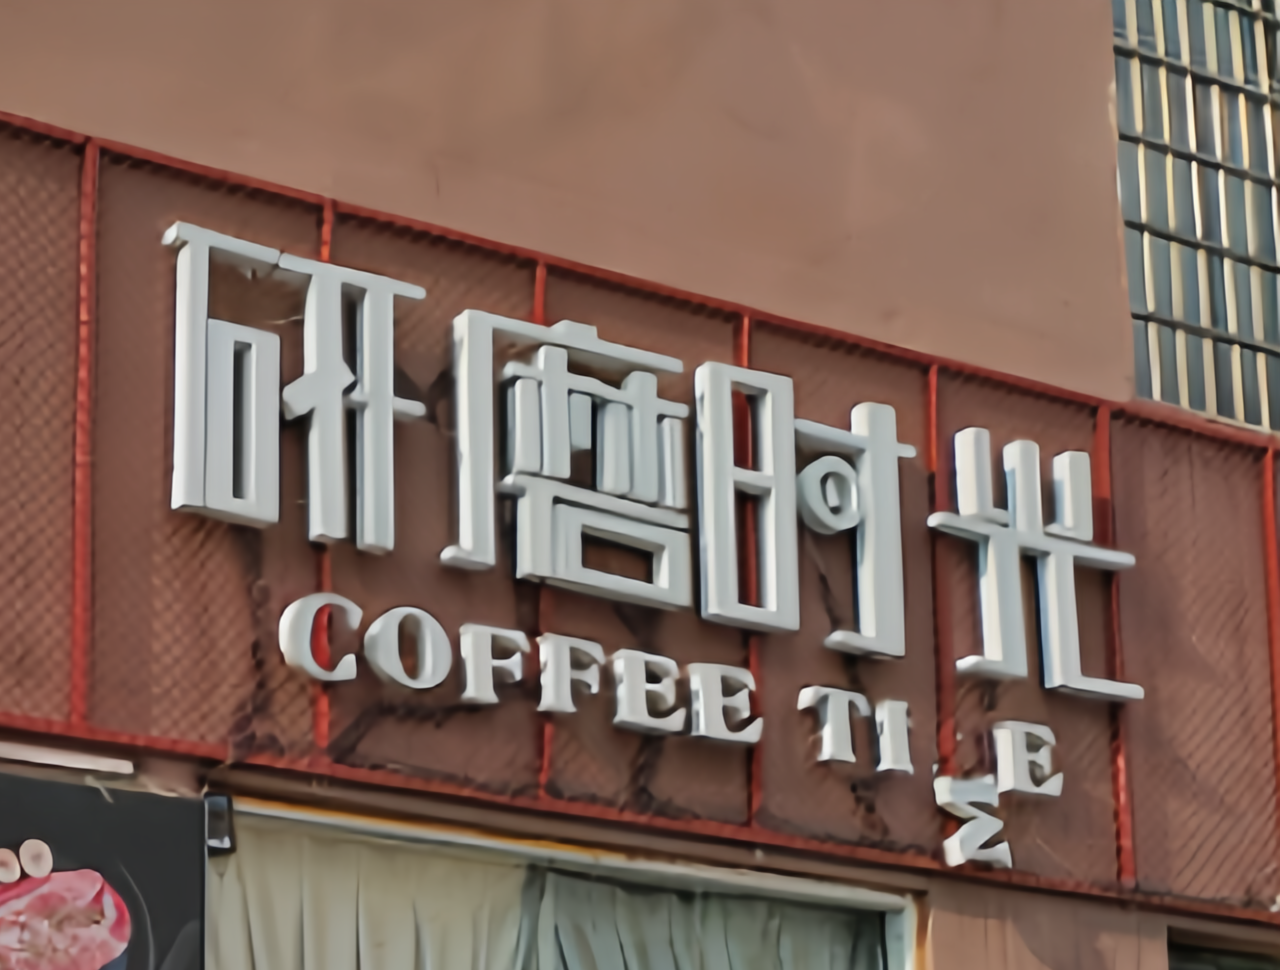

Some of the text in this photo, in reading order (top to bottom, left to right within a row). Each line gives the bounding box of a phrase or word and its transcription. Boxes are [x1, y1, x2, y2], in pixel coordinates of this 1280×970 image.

[162, 221, 1144, 700] 研磨时光
[278, 592, 764, 744] COFFEE
